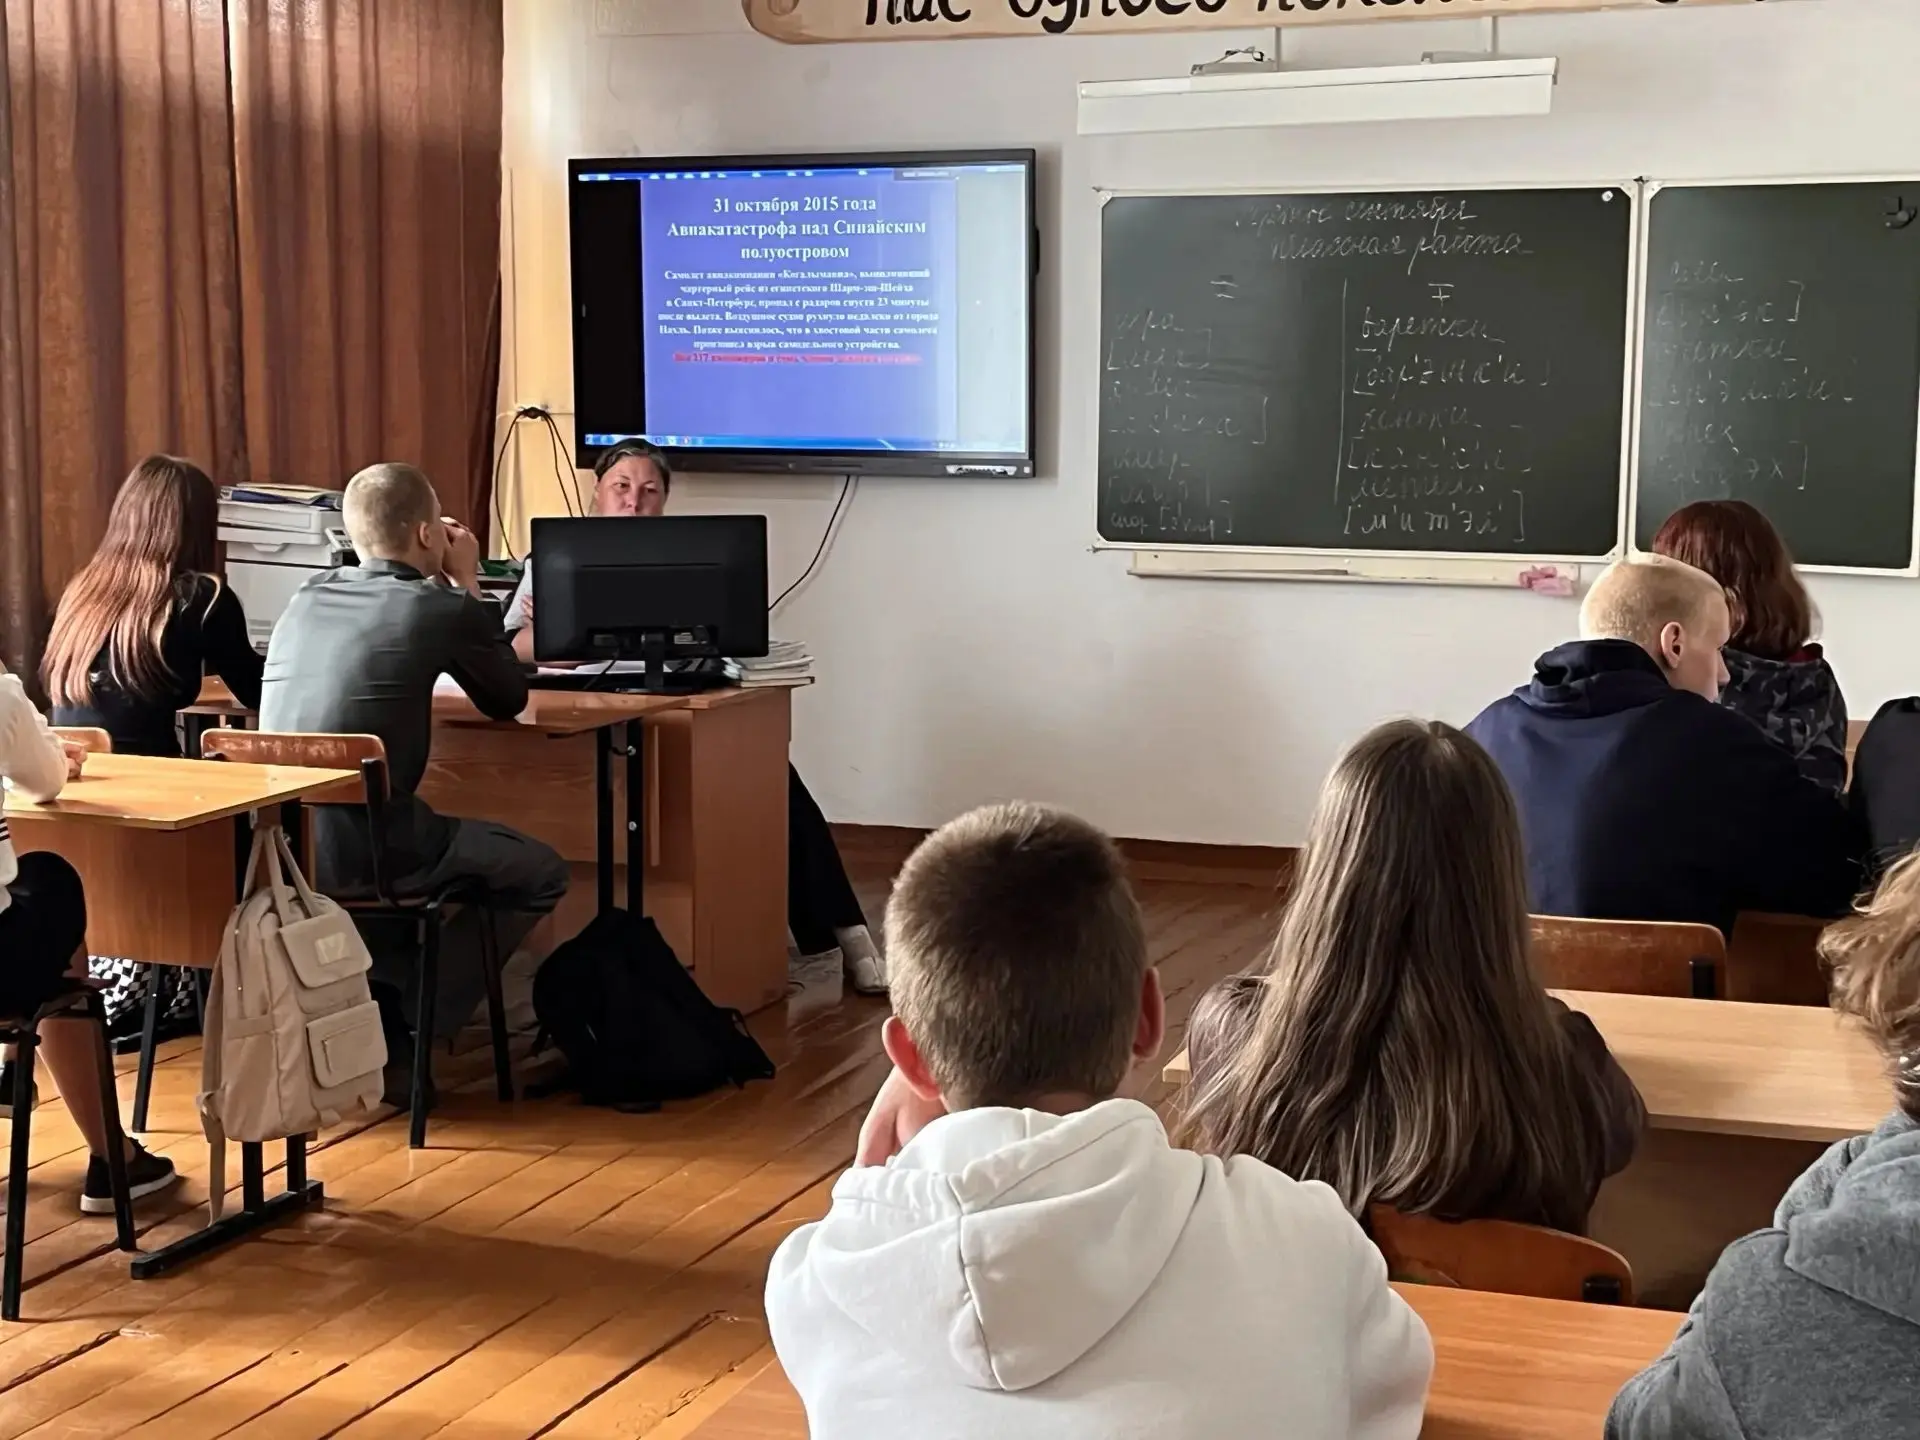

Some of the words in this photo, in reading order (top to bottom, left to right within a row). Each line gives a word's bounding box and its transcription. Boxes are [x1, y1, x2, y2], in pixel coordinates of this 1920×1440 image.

[713, 198, 730, 213] 31
[735, 198, 799, 216] октября
[803, 196, 839, 212] 2015
[843, 199, 877, 211] года
[667, 220, 797, 239] Авиакатастрофа
[802, 223, 829, 236] над
[834, 219, 927, 236] Синайским
[740, 246, 850, 262] полуостровом
[680, 284, 732, 295] чартерный
[734, 284, 756, 295] рейс
[802, 299, 841, 309] радаров
[843, 299, 875, 308] спустя
[813, 325, 861, 335] хвостовой
